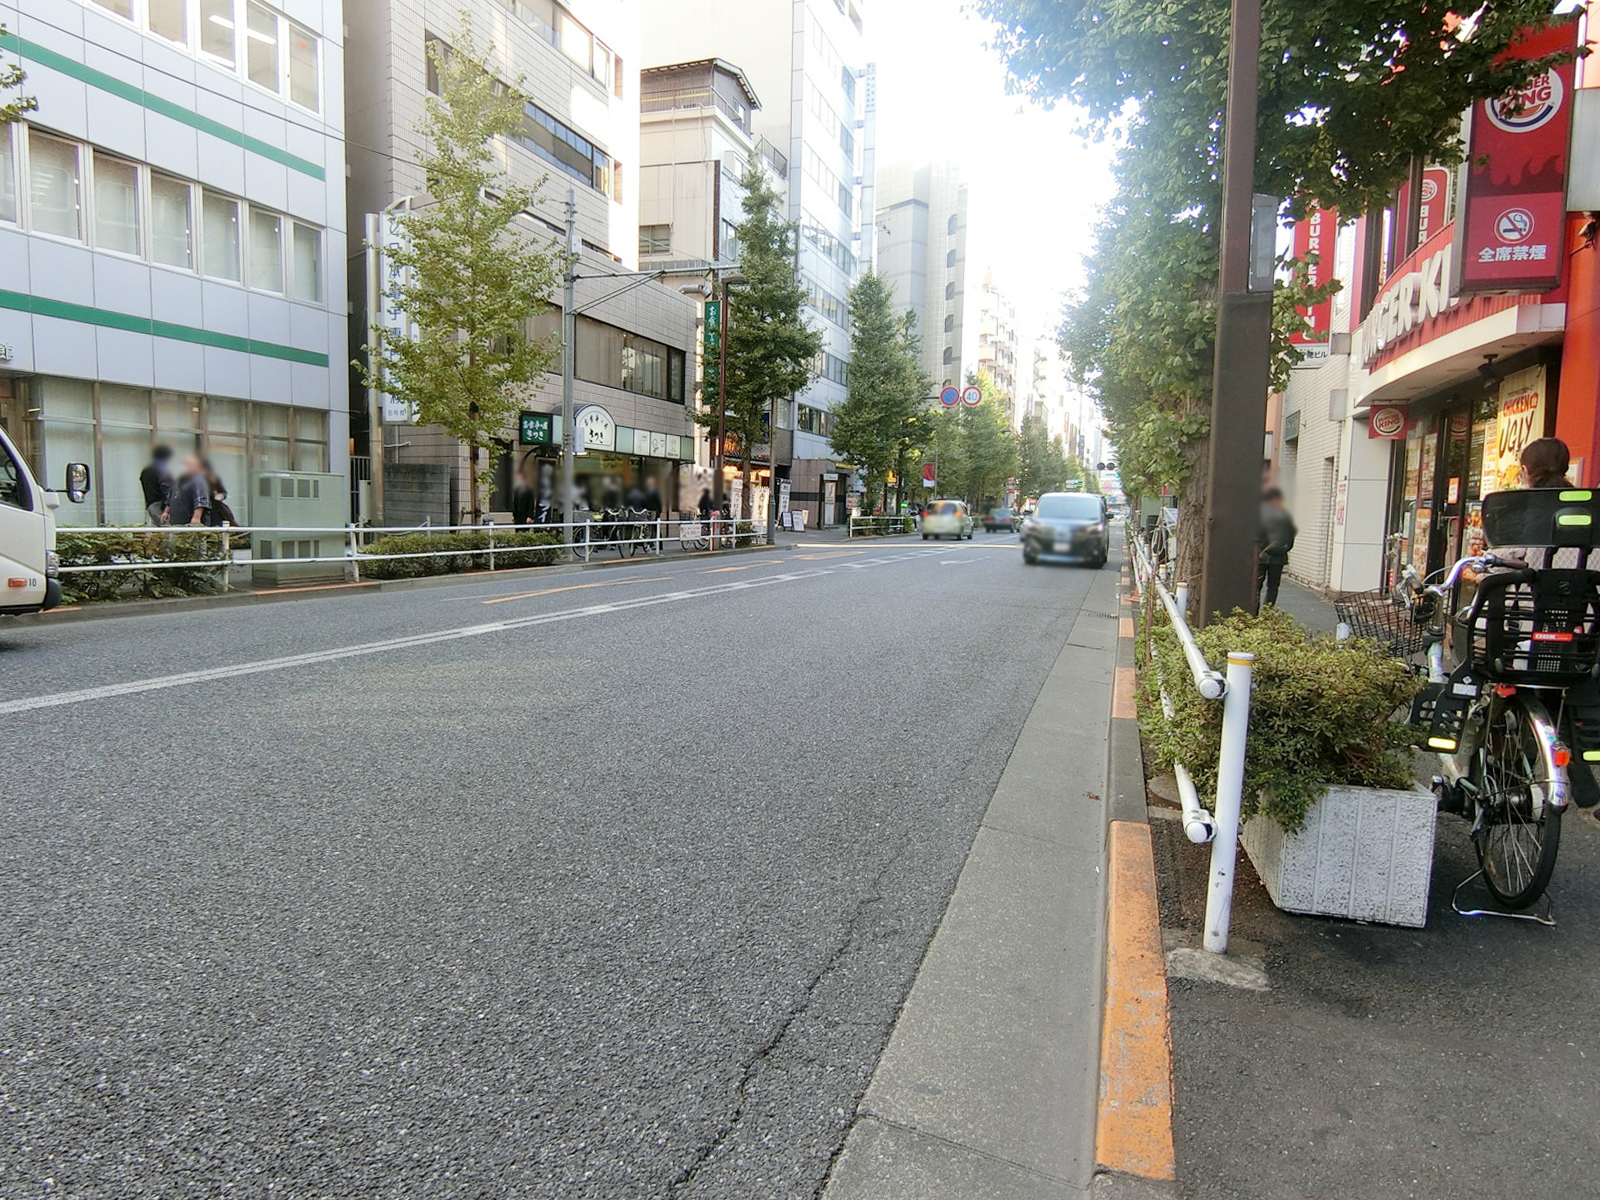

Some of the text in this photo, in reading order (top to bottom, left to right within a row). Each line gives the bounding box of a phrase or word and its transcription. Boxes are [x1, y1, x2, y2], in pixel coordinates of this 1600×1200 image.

[1478, 244, 1548, 263] 全席禁煙
[966, 391, 978, 401] 40
[1378, 417, 1401, 429] KING
[1498, 410, 1535, 460] UGLY
[28, 578, 37, 587] 10
